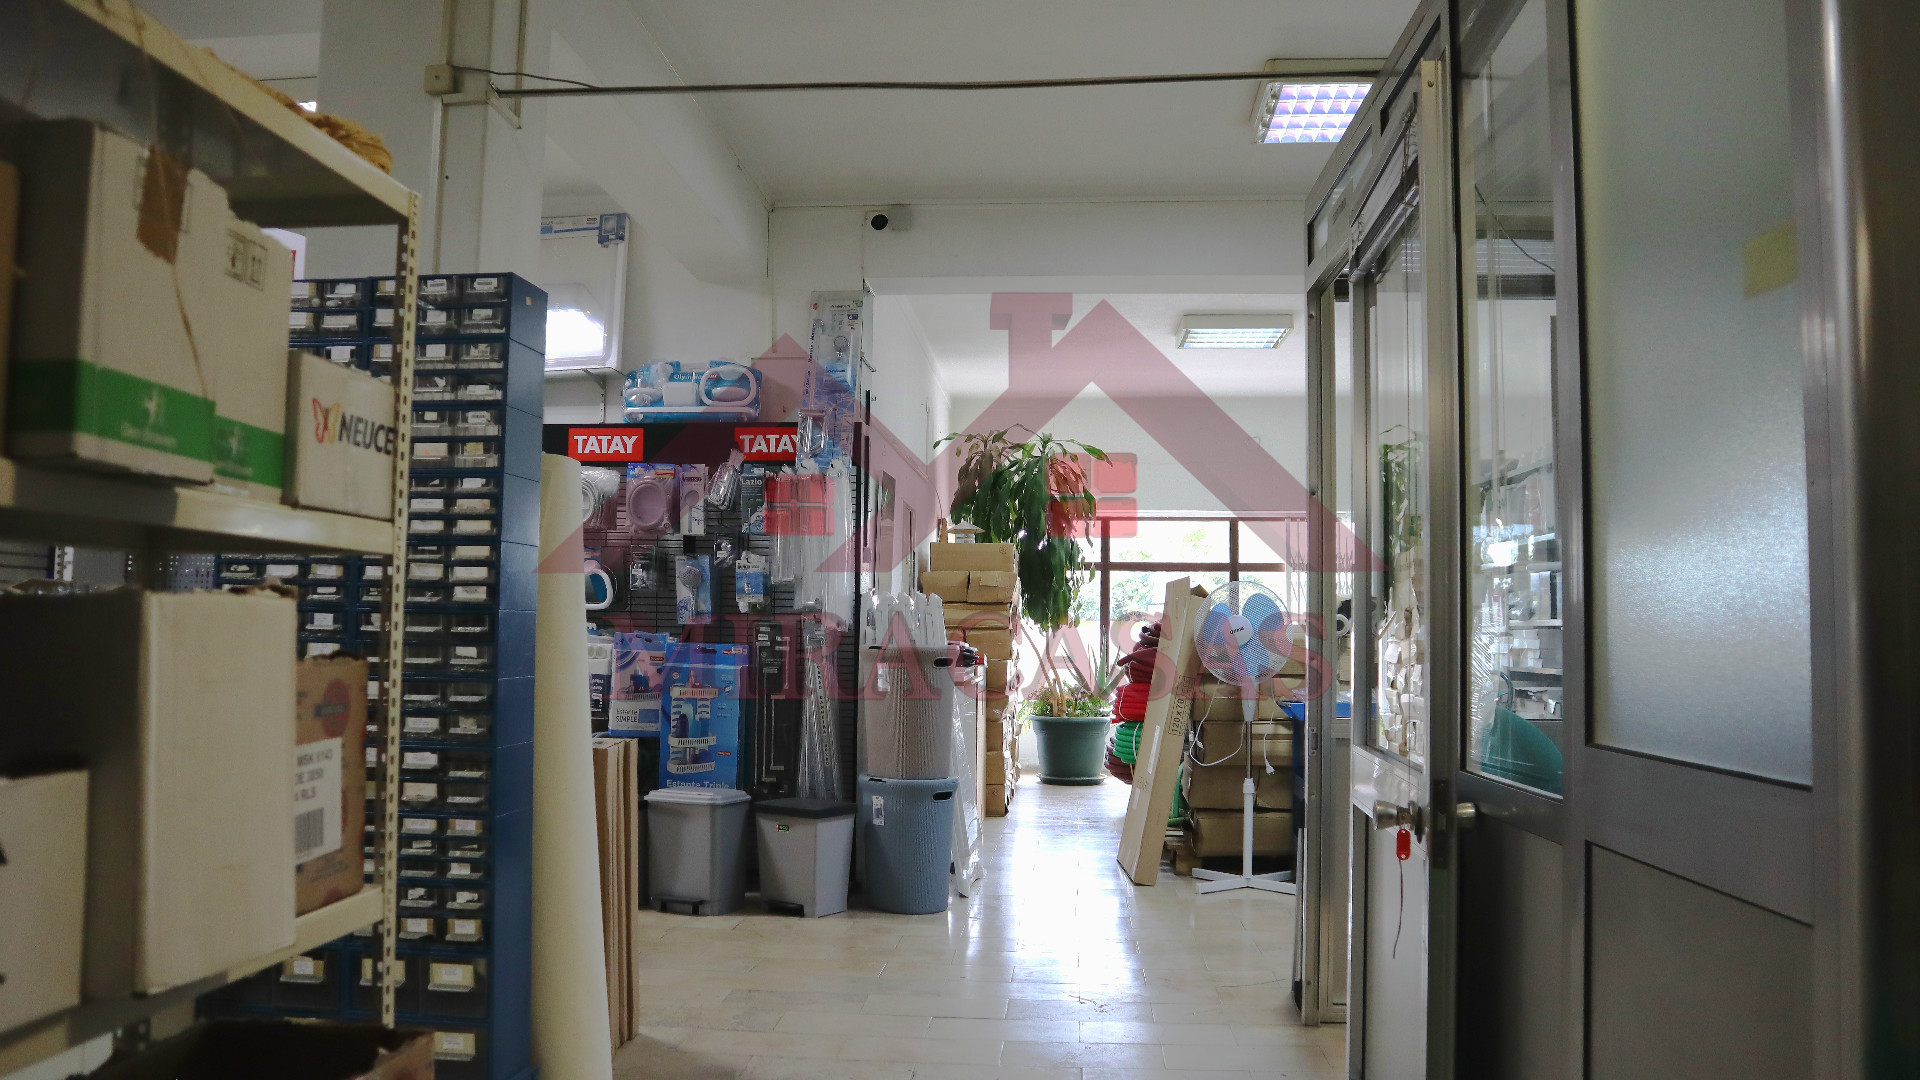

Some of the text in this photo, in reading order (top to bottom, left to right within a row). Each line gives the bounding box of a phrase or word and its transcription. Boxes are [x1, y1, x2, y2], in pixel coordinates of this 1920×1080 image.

[338, 412, 396, 455] NEUCE
[573, 435, 638, 454] TATAY
[741, 477, 763, 486] Lazio
